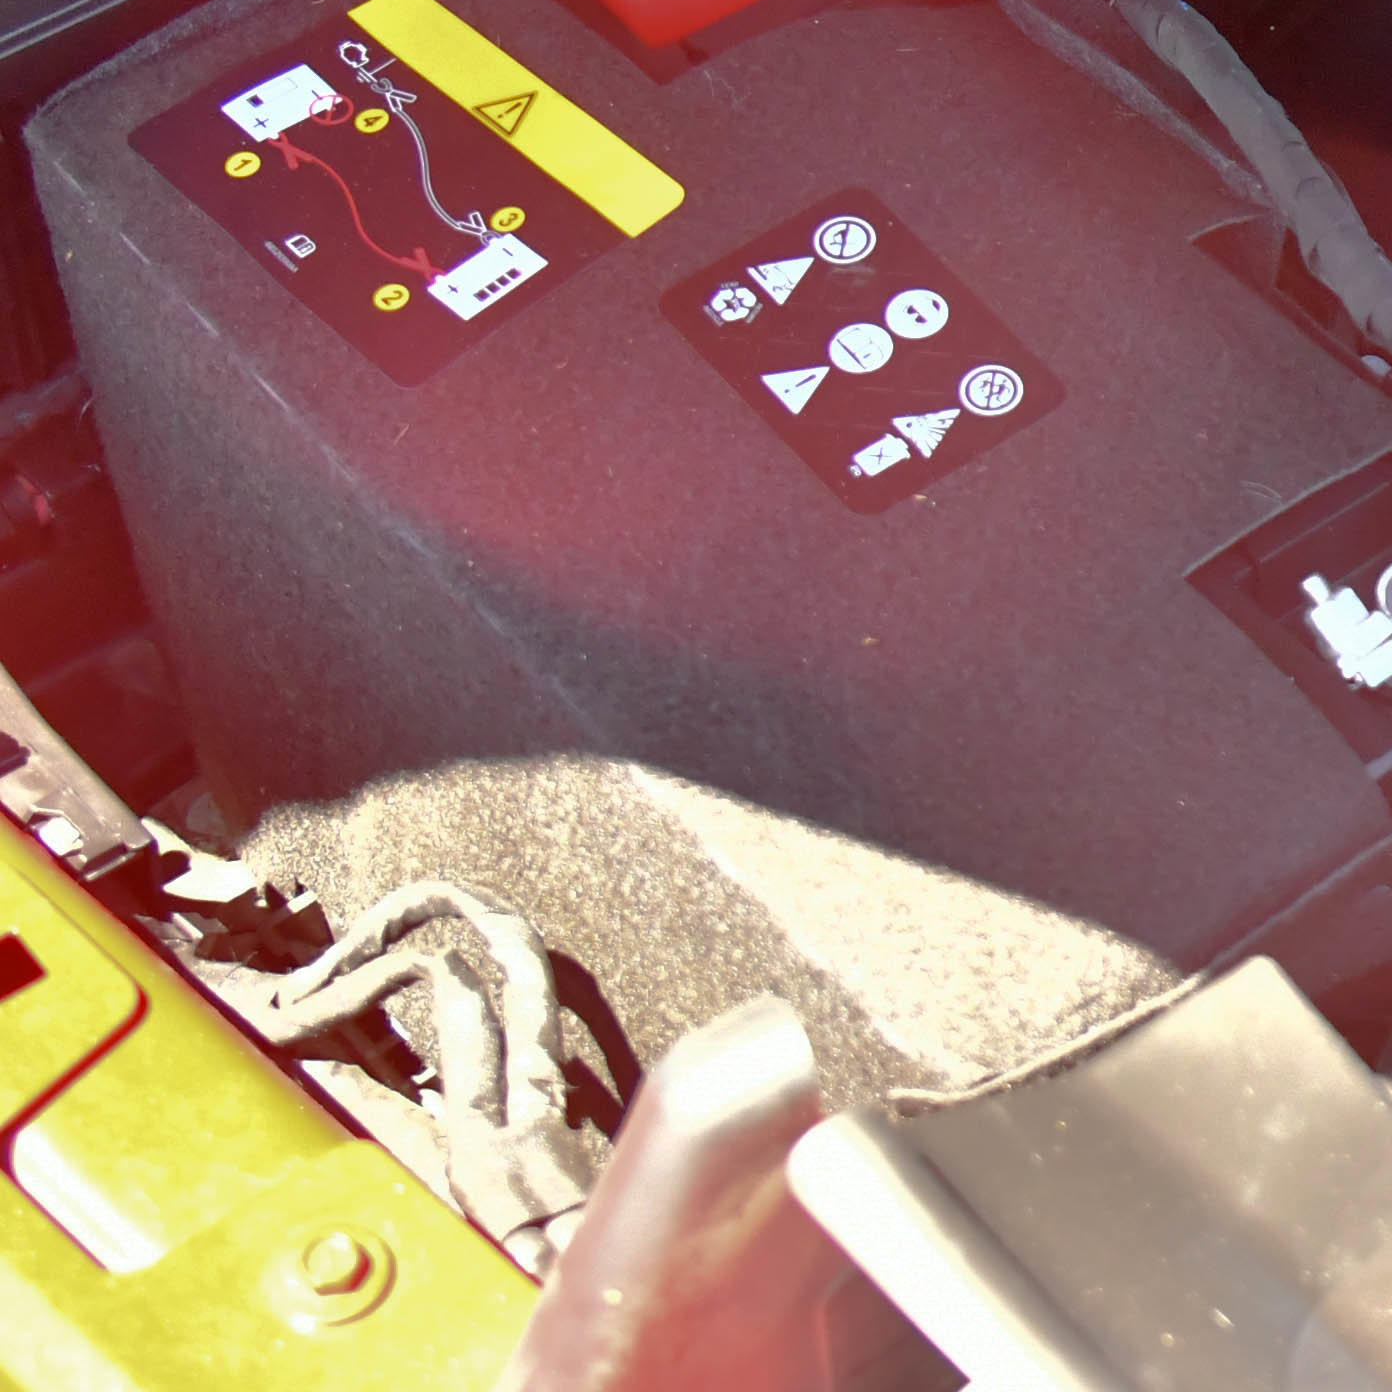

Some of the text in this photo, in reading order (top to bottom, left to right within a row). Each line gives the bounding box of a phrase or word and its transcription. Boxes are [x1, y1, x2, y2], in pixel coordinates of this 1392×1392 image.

[363, 114, 381, 128] 4
[233, 158, 252, 171] 1
[497, 213, 518, 226] 3
[381, 291, 402, 306] 2
